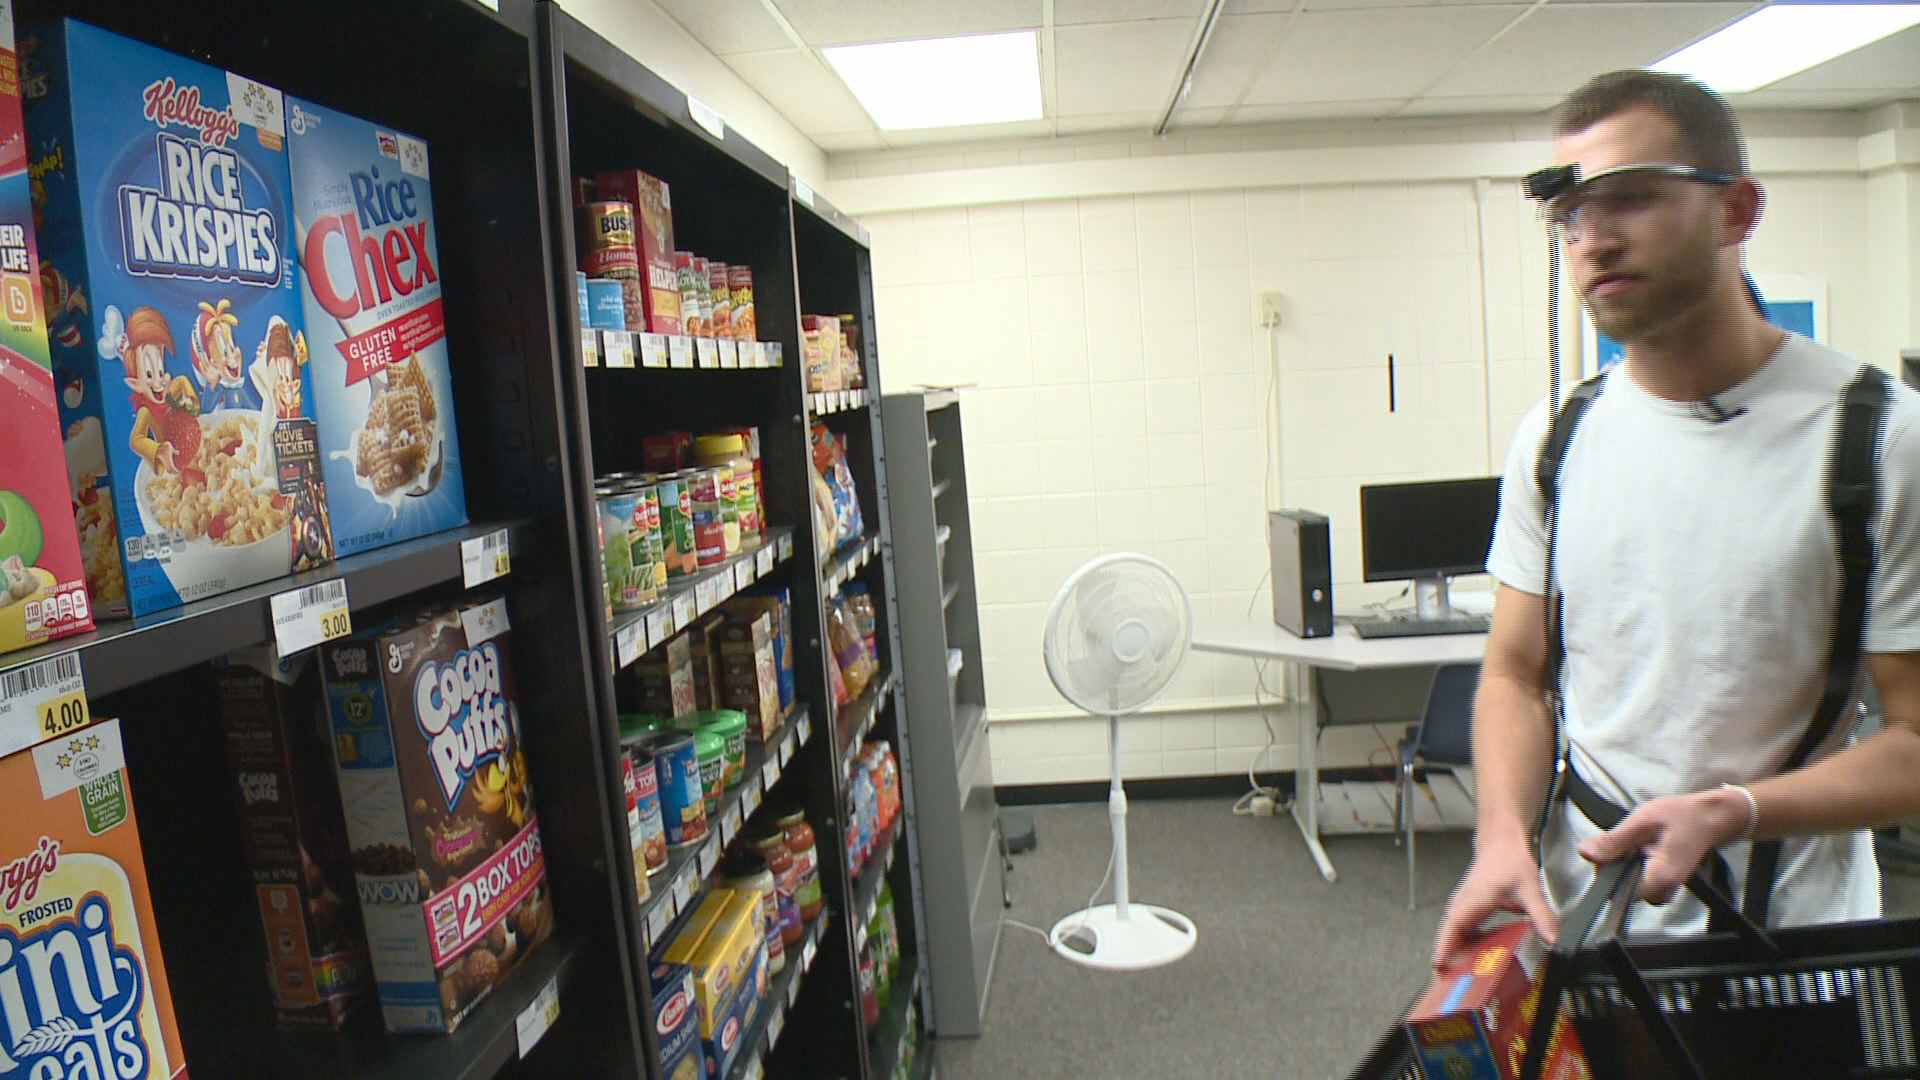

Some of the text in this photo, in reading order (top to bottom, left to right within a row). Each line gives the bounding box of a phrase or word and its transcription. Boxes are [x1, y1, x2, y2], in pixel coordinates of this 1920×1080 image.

[144, 79, 238, 144] Kellogg's
[165, 140, 241, 211] RICE
[350, 164, 417, 230] Rice
[0, 225, 24, 247] EIR
[129, 192, 276, 274] KRISPIES
[2, 248, 29, 271] LIFE
[305, 211, 438, 320] Chex
[349, 326, 397, 359] GLUTEN
[362, 348, 393, 372] FREE
[274, 428, 304, 443] MOVIE
[278, 422, 291, 431] GET
[275, 440, 315, 455] TICKETS
[127, 538, 140, 551] 130
[26, 604, 39, 617] 110
[322, 613, 347, 638] 3.00
[72, 680, 82, 690] OZ
[417, 646, 502, 734] Cocoa
[45, 698, 84, 734] 4.00
[431, 695, 508, 808] Puffs
[83, 773, 118, 792] WHOLE
[86, 780, 119, 805] GRAIN
[357, 878, 421, 905] WOW
[457, 881, 483, 939] 2
[476, 856, 512, 908] BOX
[510, 827, 542, 874] TOPS
[18, 896, 74, 928] FROSTED
[0, 903, 119, 1060] ini
